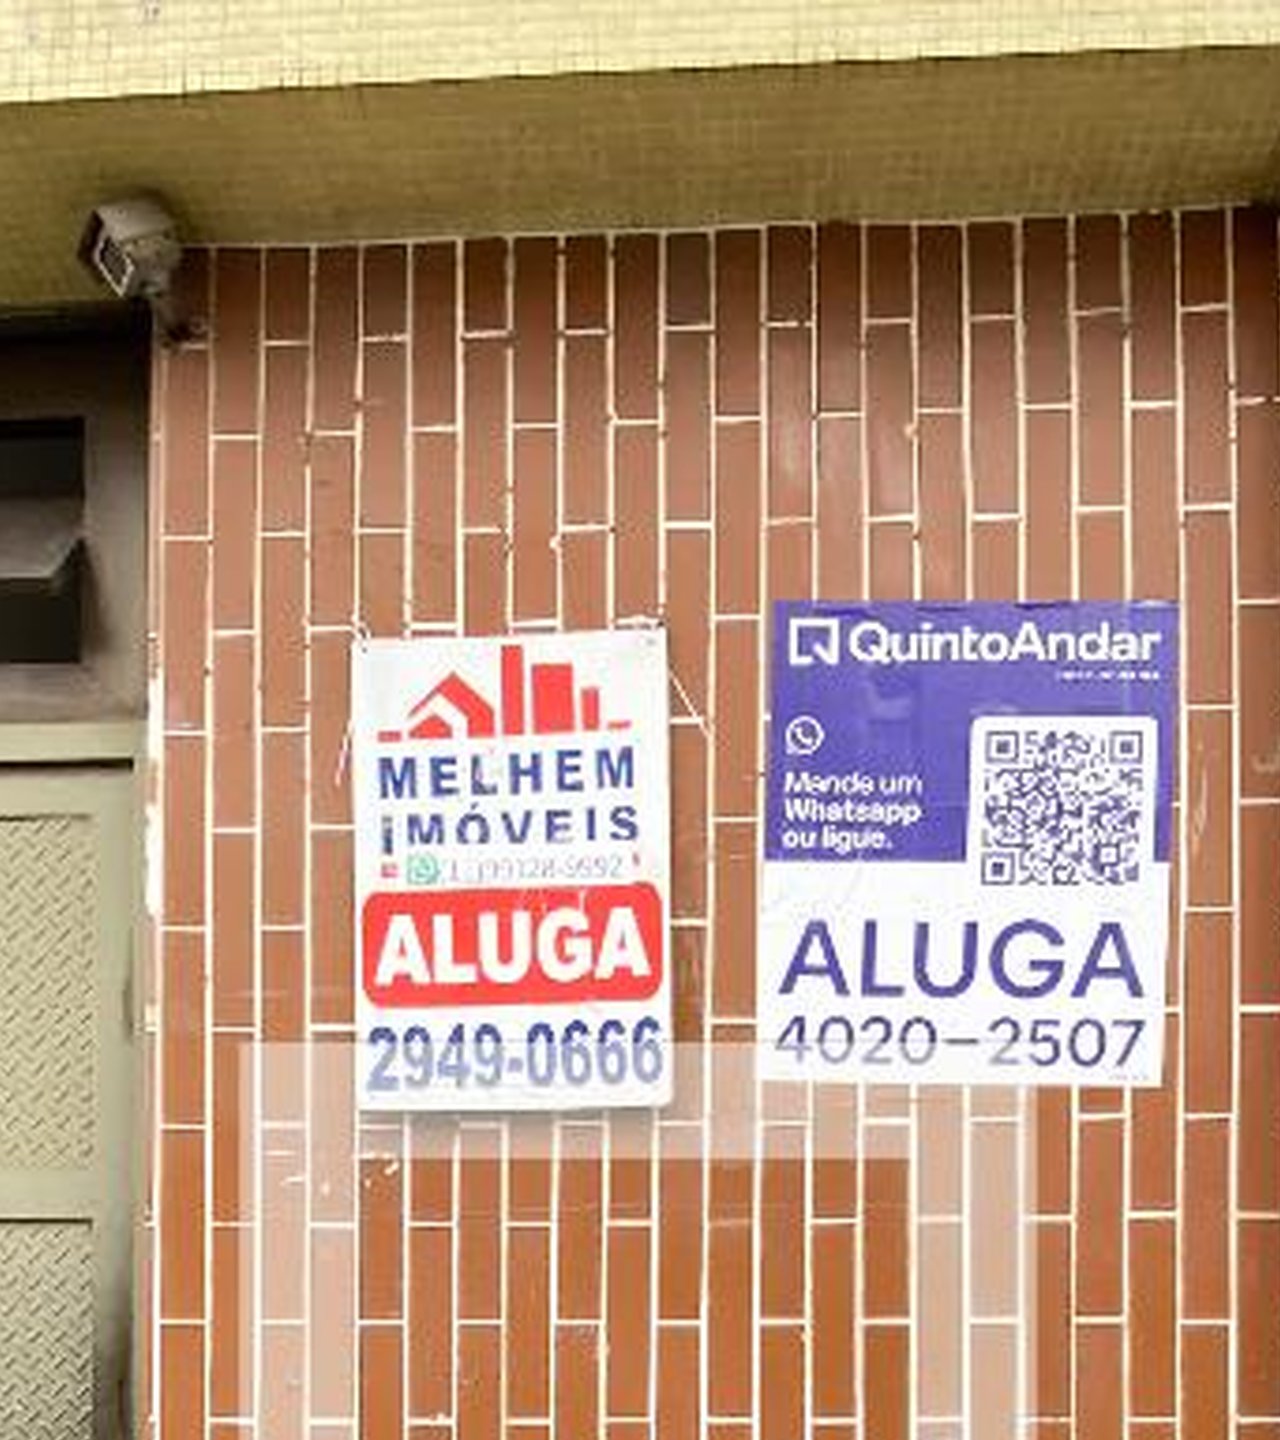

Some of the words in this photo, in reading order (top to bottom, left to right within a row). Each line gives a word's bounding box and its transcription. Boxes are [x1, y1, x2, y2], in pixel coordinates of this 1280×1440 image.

[849, 621, 1162, 665] QuintoAndar
[378, 746, 634, 799] MELHEM
[784, 773, 874, 794] Mande
[879, 776, 923, 794] um
[380, 803, 639, 855] IMÓVEIS
[784, 799, 923, 827] Whatsapp
[783, 830, 816, 849] ou
[822, 826, 893, 854] ligue.
[374, 906, 653, 987] ALUGA
[777, 918, 1145, 999] ALUGA
[366, 1016, 663, 1092] 2949-0666
[775, 1015, 1146, 1067] 4020-2507
